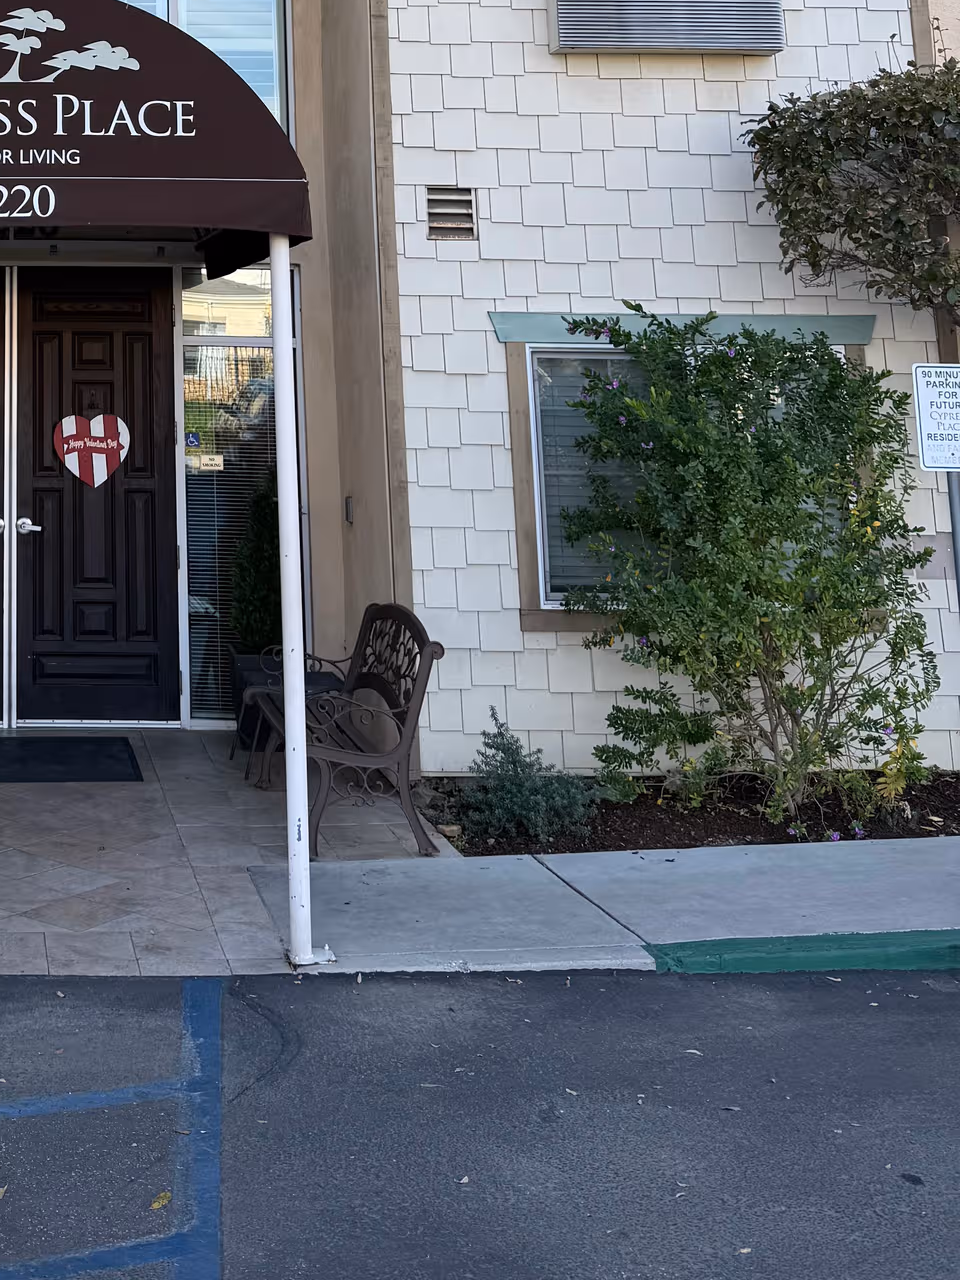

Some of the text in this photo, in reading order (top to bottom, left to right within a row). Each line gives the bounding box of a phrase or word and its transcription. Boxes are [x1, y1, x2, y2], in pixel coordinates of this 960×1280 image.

[52, 93, 197, 137] PLACE
[19, 149, 80, 165] LIVING
[921, 370, 932, 379] 90
[938, 391, 958, 400] FOR
[927, 432, 960, 441] RESIDE
[68, 439, 85, 449] Happy
[107, 438, 118, 449] Day
